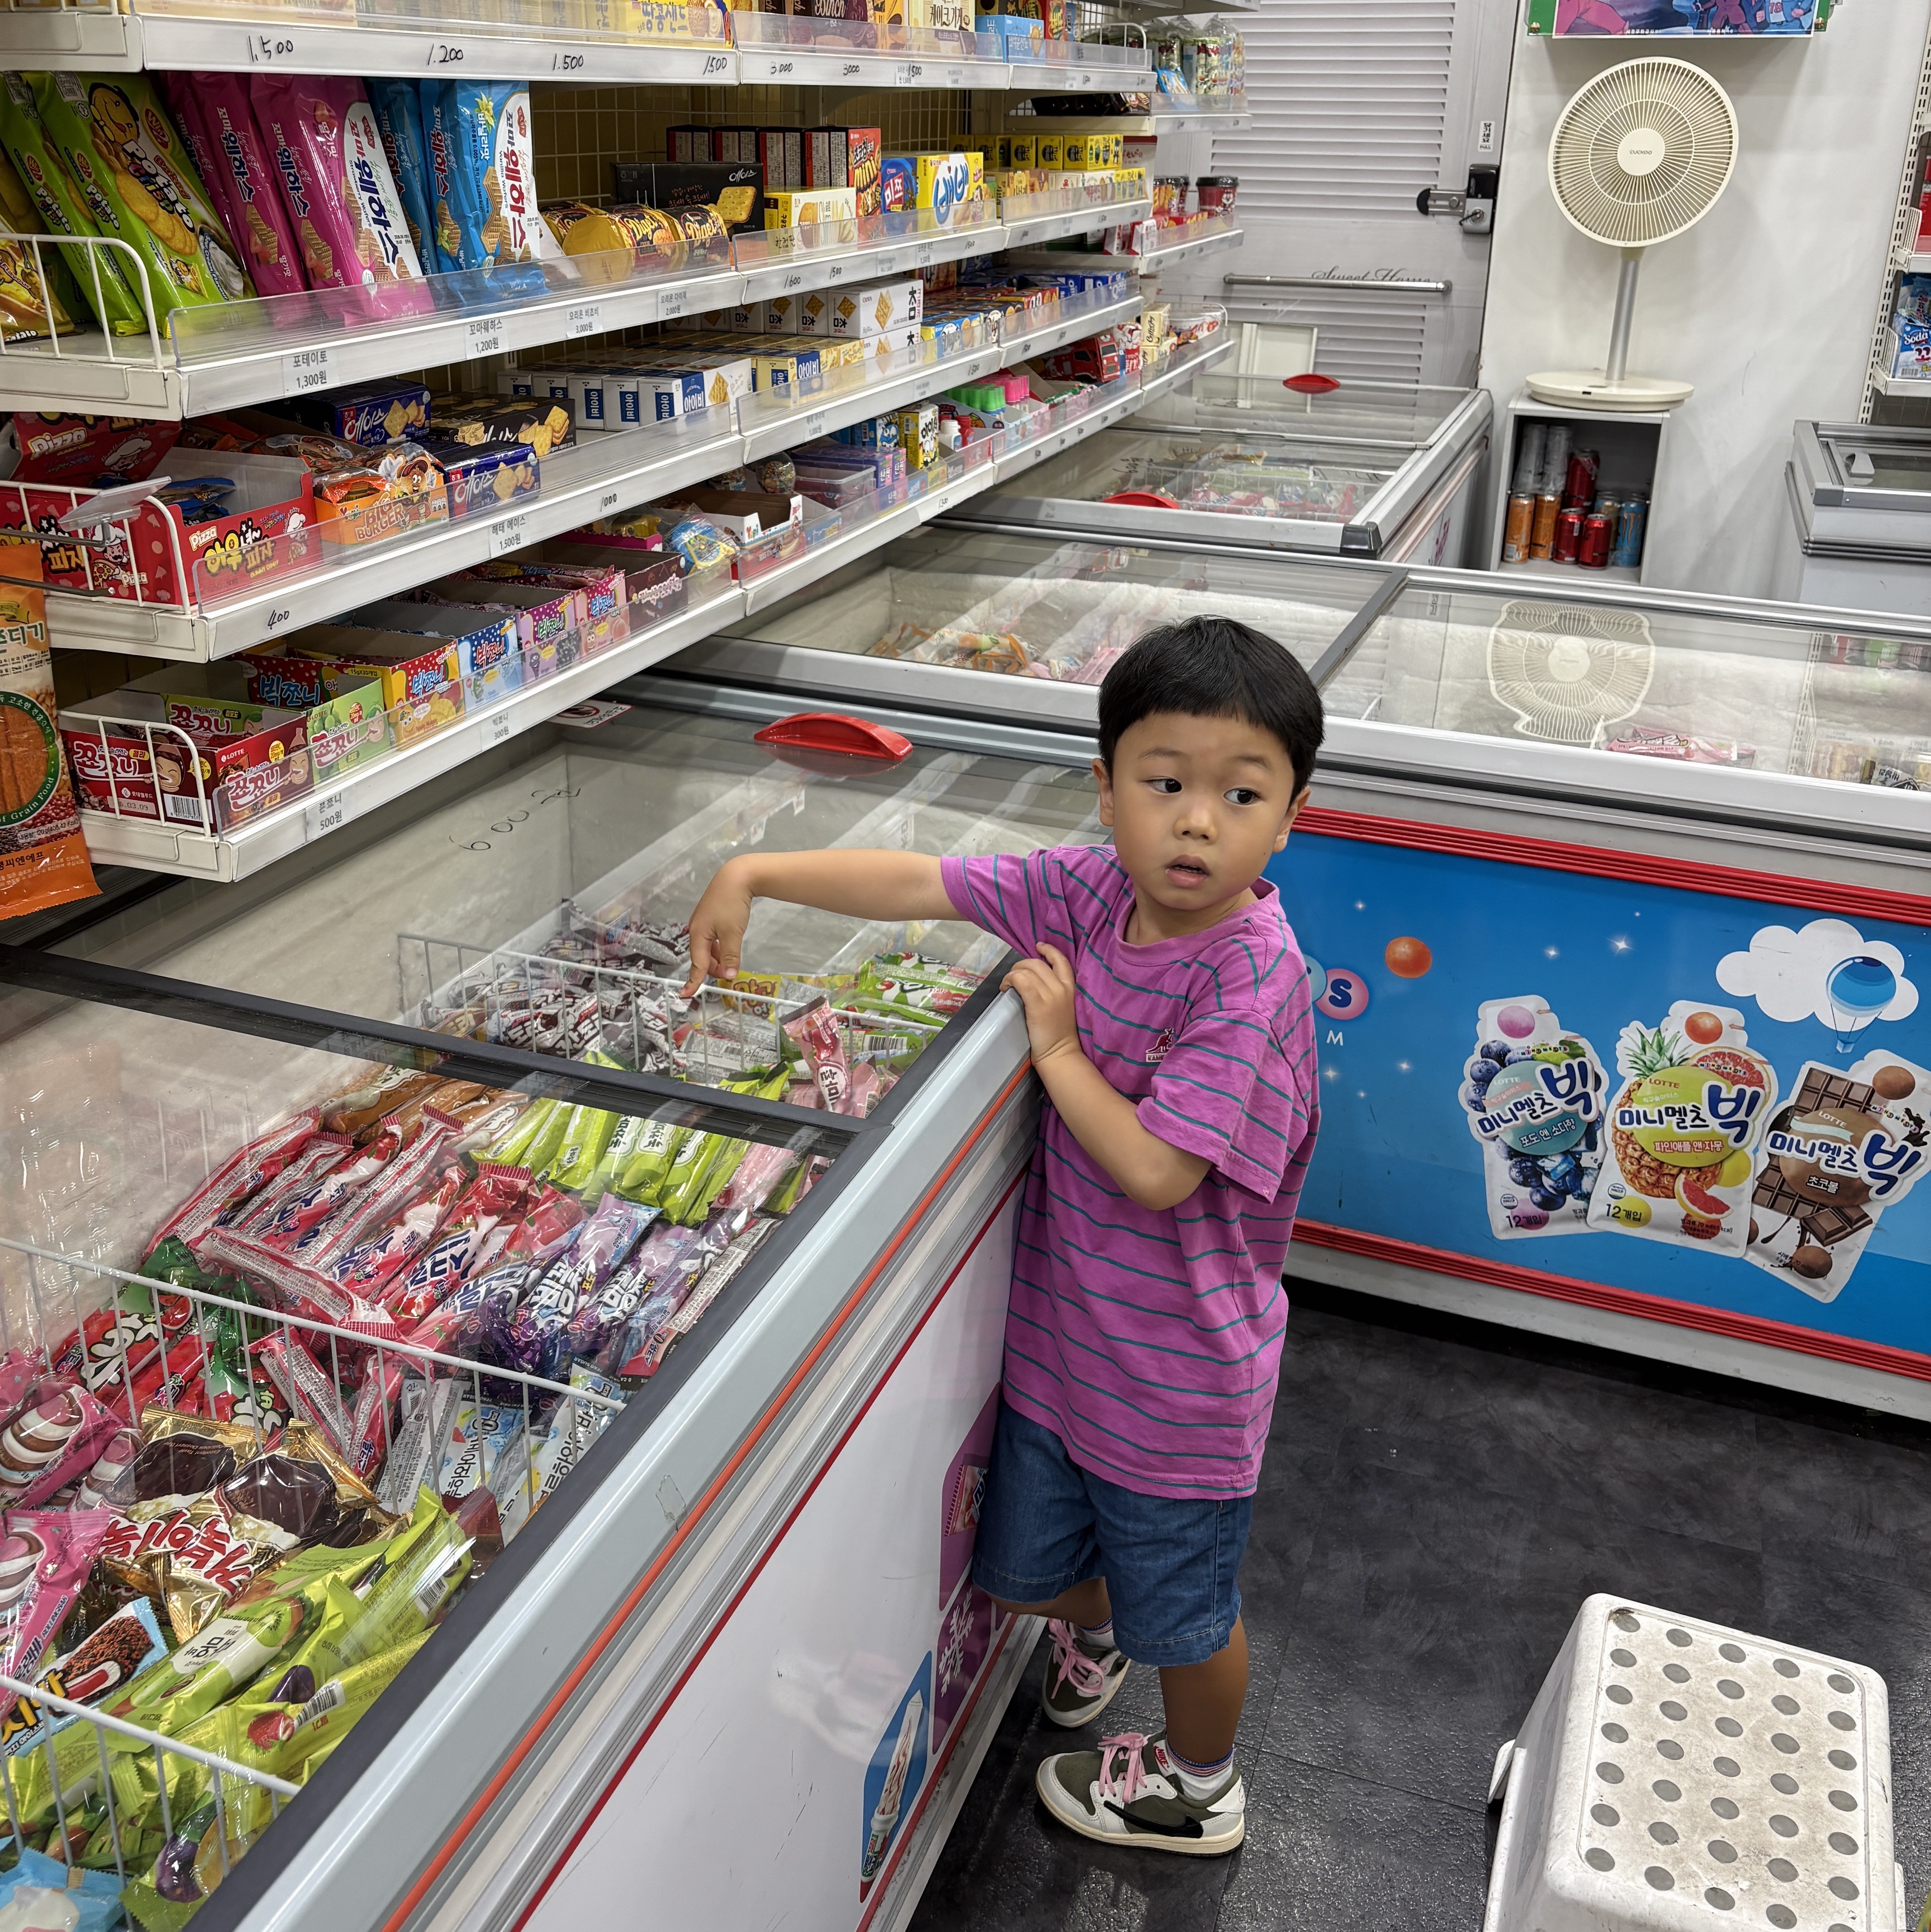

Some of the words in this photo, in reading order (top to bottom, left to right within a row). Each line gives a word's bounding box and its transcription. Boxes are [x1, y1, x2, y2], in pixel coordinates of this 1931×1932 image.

[477, 112, 491, 161] 바닐라맛
[123, 139, 195, 233] Potato
[729, 169, 757, 183] 에이스
[349, 160, 362, 201] Strawberry
[361, 202, 372, 228] Wafers
[884, 176, 904, 206] 미쯔
[86, 184, 120, 230] Potato
[569, 309, 583, 321] 오리온
[469, 319, 503, 335] 꼬마웨하스
[576, 321, 593, 334] 3,000원
[475, 336, 499, 353] 1,200원
[1903, 331, 1929, 345] Soda
[294, 350, 328, 367] 포테이토
[798, 358, 820, 379] 아이비
[296, 370, 327, 389] 1,300원
[684, 391, 704, 412] 아이비
[344, 406, 388, 441] 에이스
[30, 429, 86, 458] Pizza
[454, 469, 497, 504] 에이스
[355, 503, 406, 541] BURGER
[364, 498, 394, 528] BIG
[492, 522, 505, 535] 해태
[507, 515, 526, 531] 에이스
[190, 527, 217, 551] Pizza
[499, 532, 521, 550] 1,500원
[268, 610, 289, 630] 400
[311, 710, 327, 720] LOTTE
[494, 725, 509, 740] 300원
[226, 748, 245, 760] LOTTE
[10, 802, 39, 820] Grain
[37, 777, 55, 801] Food
[320, 809, 342, 831] 500원
[1492, 1076, 1521, 1085] LOTTE
[1649, 1078, 1680, 1089] LOTTE
[1478, 1093, 1558, 1134] 미니멜츠
[1540, 1060, 1594, 1116] 빅
[1619, 1105, 1710, 1129] 미니멜츠
[1707, 1084, 1761, 1144] 빅
[1818, 1111, 1848, 1129] LOTTE
[1520, 1132, 1538, 1147] 포도
[1540, 1128, 1551, 1142] 앤
[1552, 1118, 1576, 1138] 소다향
[1654, 1141, 1692, 1152] 파인애플
[1693, 1141, 1703, 1152] 앤
[1703, 1140, 1724, 1152] 자몽
[1770, 1133, 1859, 1173] 미니멜츠
[1863, 1133, 1922, 1195] 빅
[1806, 1175, 1838, 1195] 초코볼
[1505, 1214, 1542, 1229] 12개입
[1605, 1203, 1642, 1221] 12개입
[358, 1440, 374, 1472] 스크류
[42, 1595, 69, 1639] ROLLINGBAR
